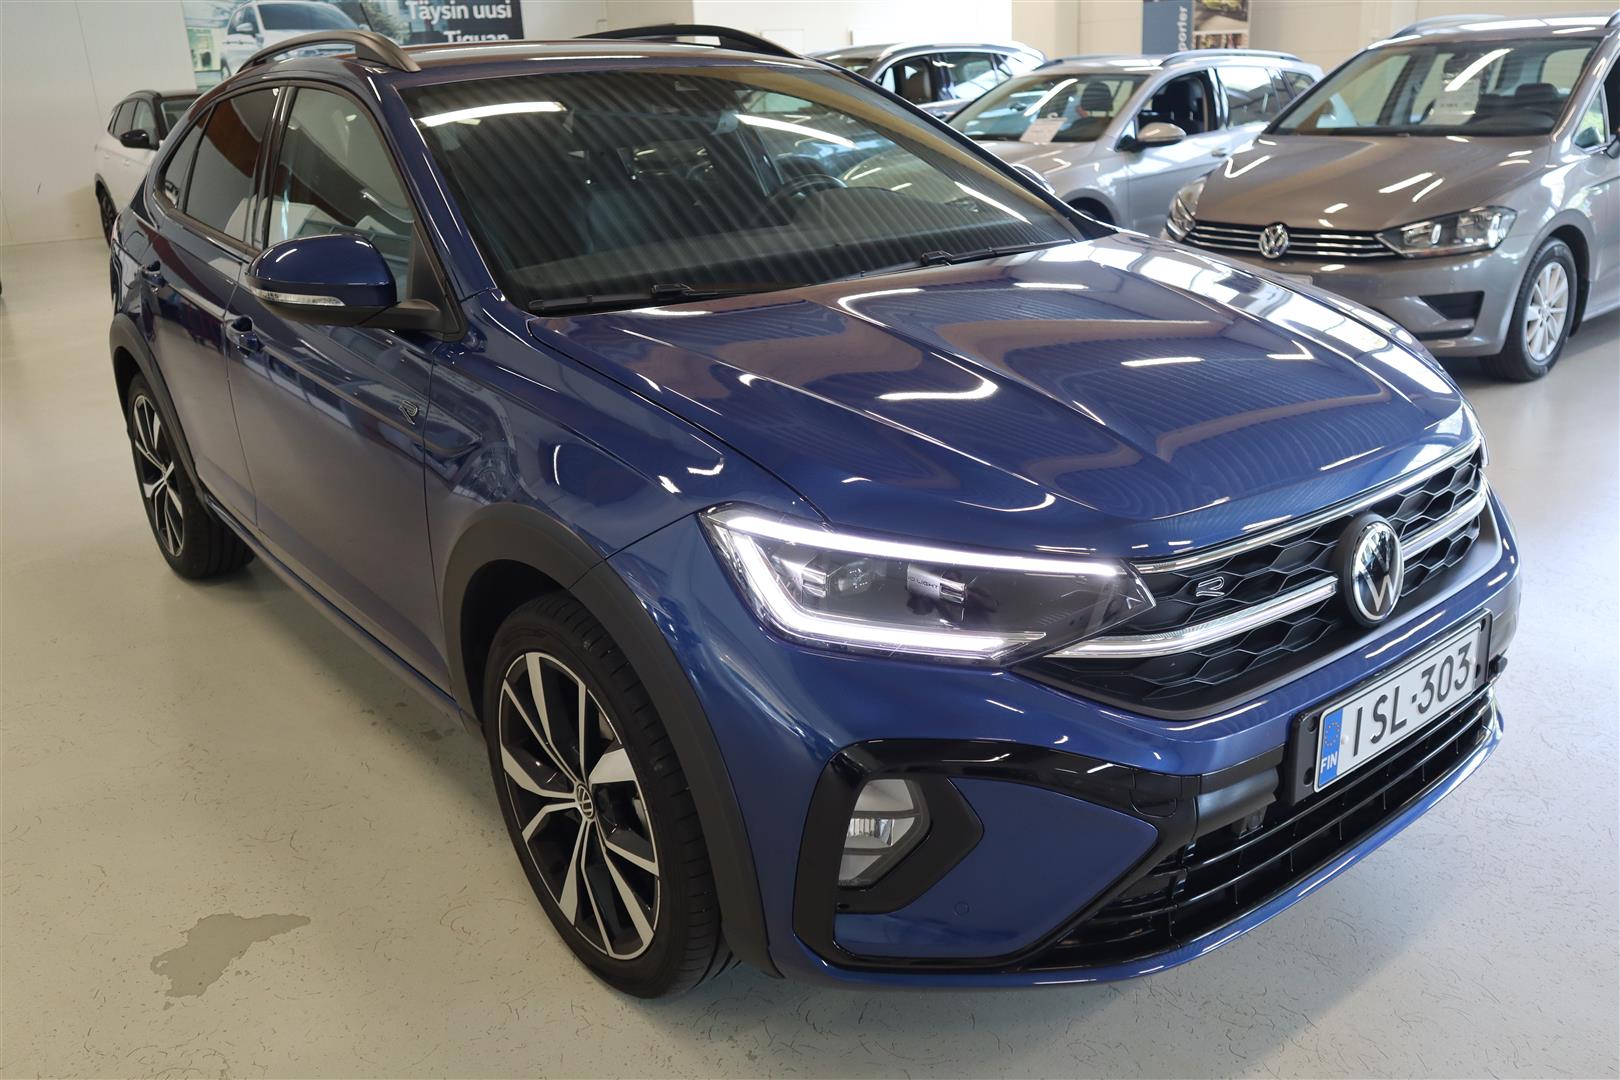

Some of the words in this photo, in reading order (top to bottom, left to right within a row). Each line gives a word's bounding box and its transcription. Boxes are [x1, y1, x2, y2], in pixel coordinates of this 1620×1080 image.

[404, 0, 469, 25] Täysin
[473, 0, 512, 19] uusi
[1353, 641, 1474, 757] ISL-303
[1320, 753, 1338, 777] FIN
